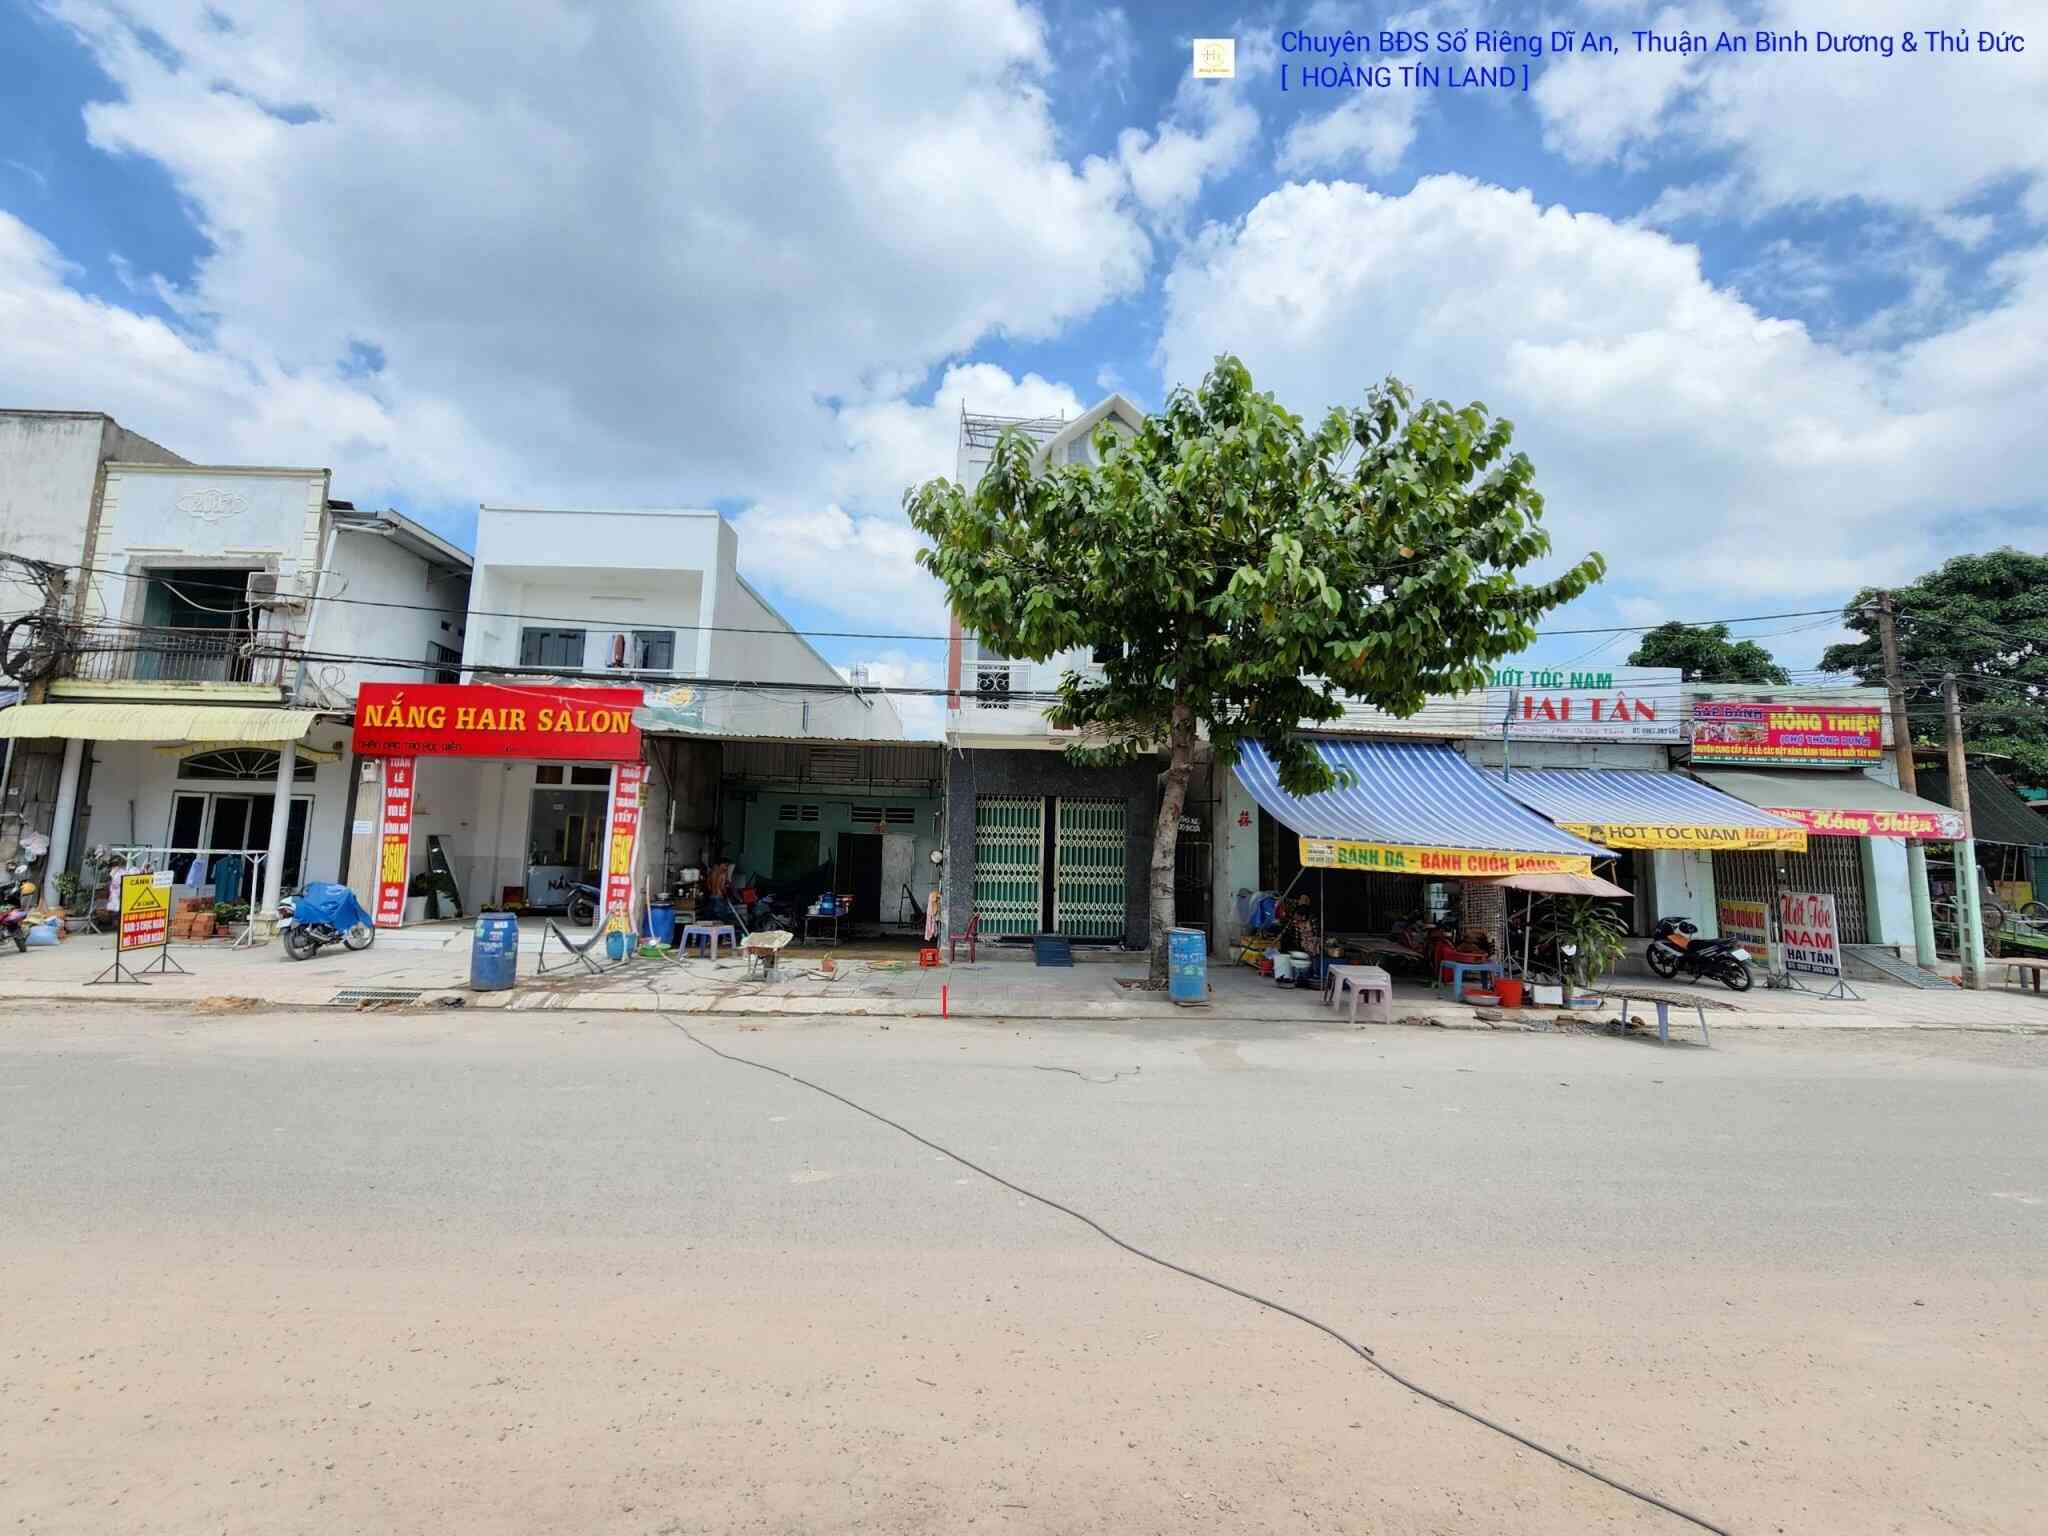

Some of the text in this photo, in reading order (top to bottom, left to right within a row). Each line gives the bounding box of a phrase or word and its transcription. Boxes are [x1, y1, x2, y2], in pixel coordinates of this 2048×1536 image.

[1570, 672, 1612, 689] NAM
[363, 692, 632, 734] NẮNG HAIR SALON
[1585, 690, 1656, 721] TÂN
[1695, 828, 1741, 841] NAM
[1338, 845, 1379, 865] BÁNH
[1420, 850, 1462, 871] BÁNH
[1783, 929, 1833, 950] NAM
[1787, 948, 1807, 961] HAI
